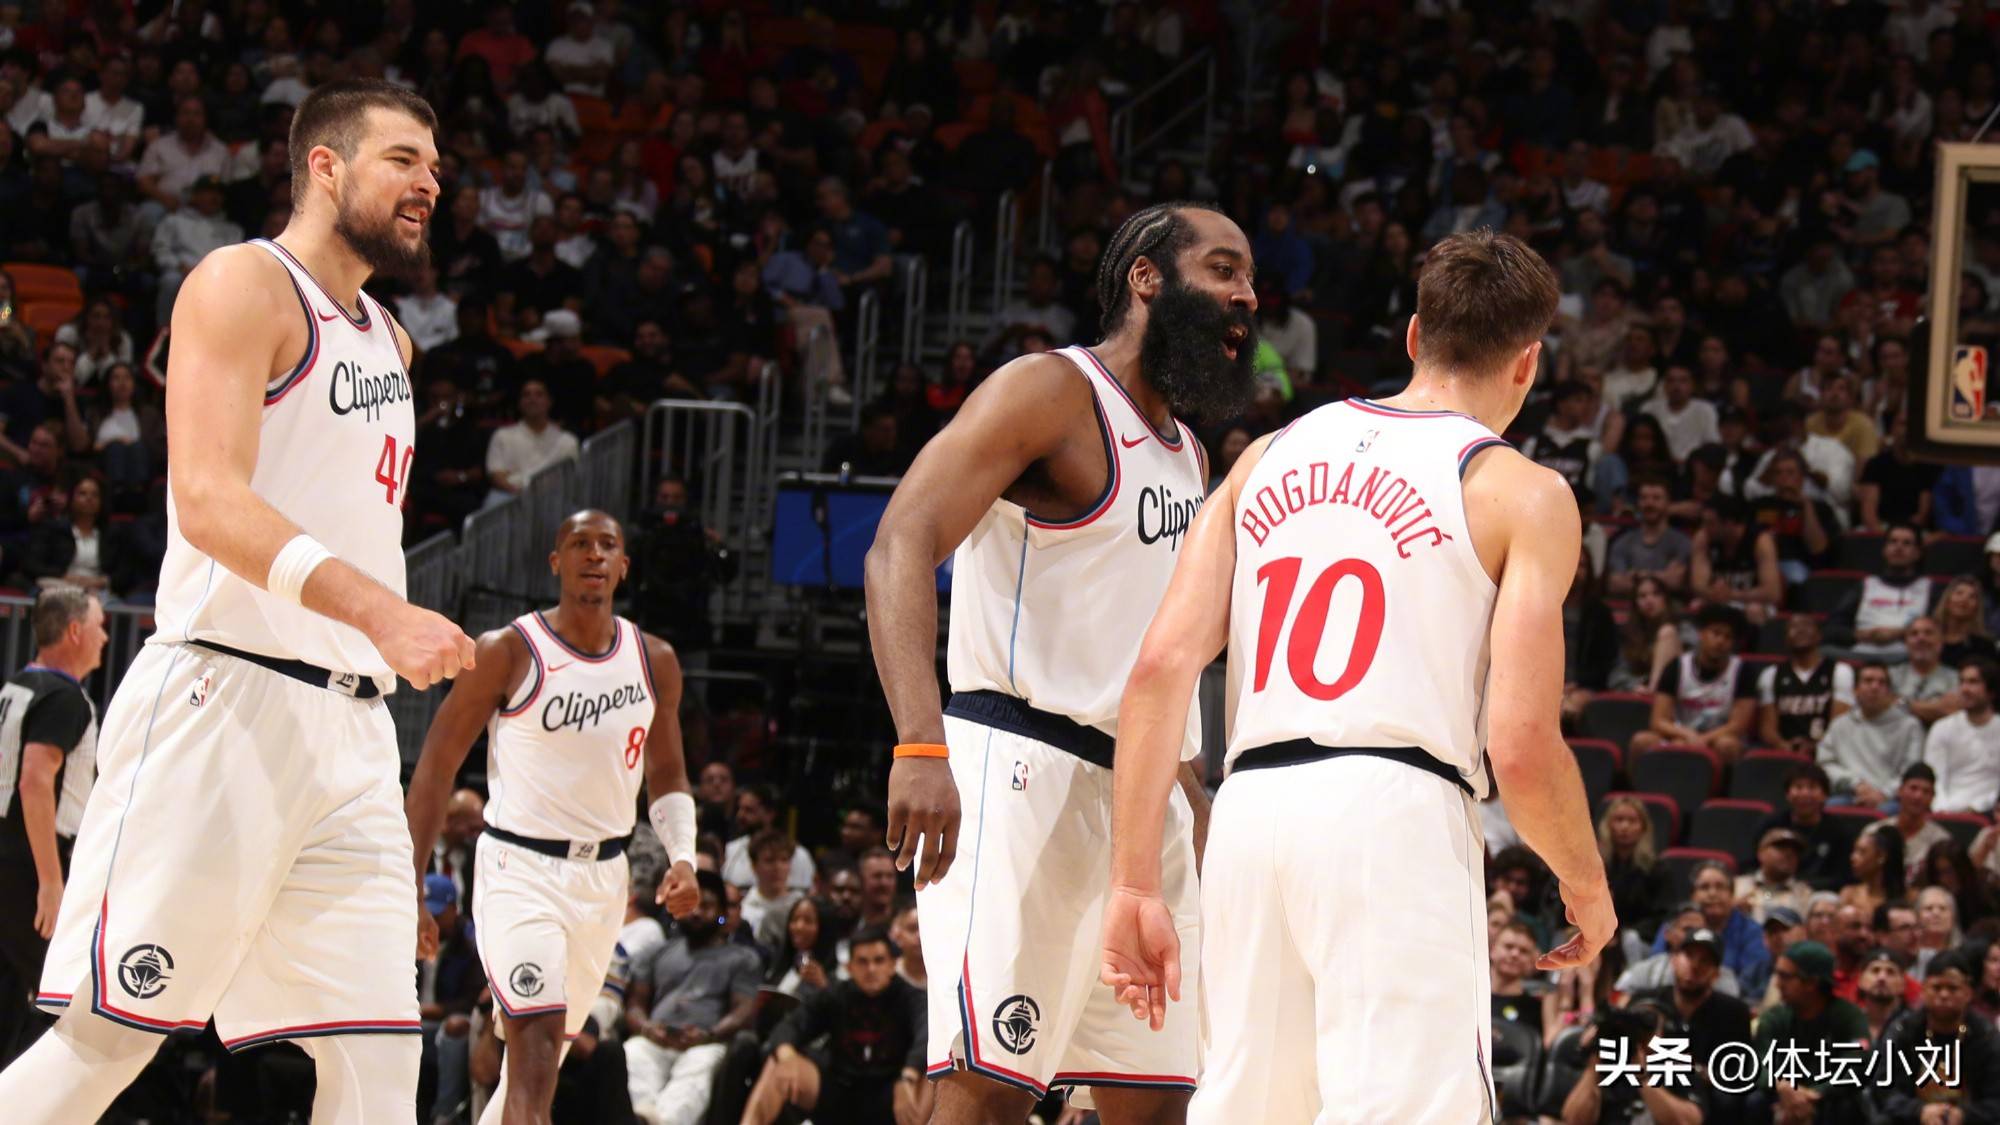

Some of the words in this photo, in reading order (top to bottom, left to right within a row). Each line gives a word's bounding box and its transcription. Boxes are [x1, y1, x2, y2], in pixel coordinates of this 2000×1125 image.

[329, 360, 410, 422] Clippers
[1241, 461, 1453, 559] BOGDANOVIĆ
[1253, 556, 1386, 701] 10
[541, 682, 647, 733] Clippers
[625, 725, 646, 770] 8
